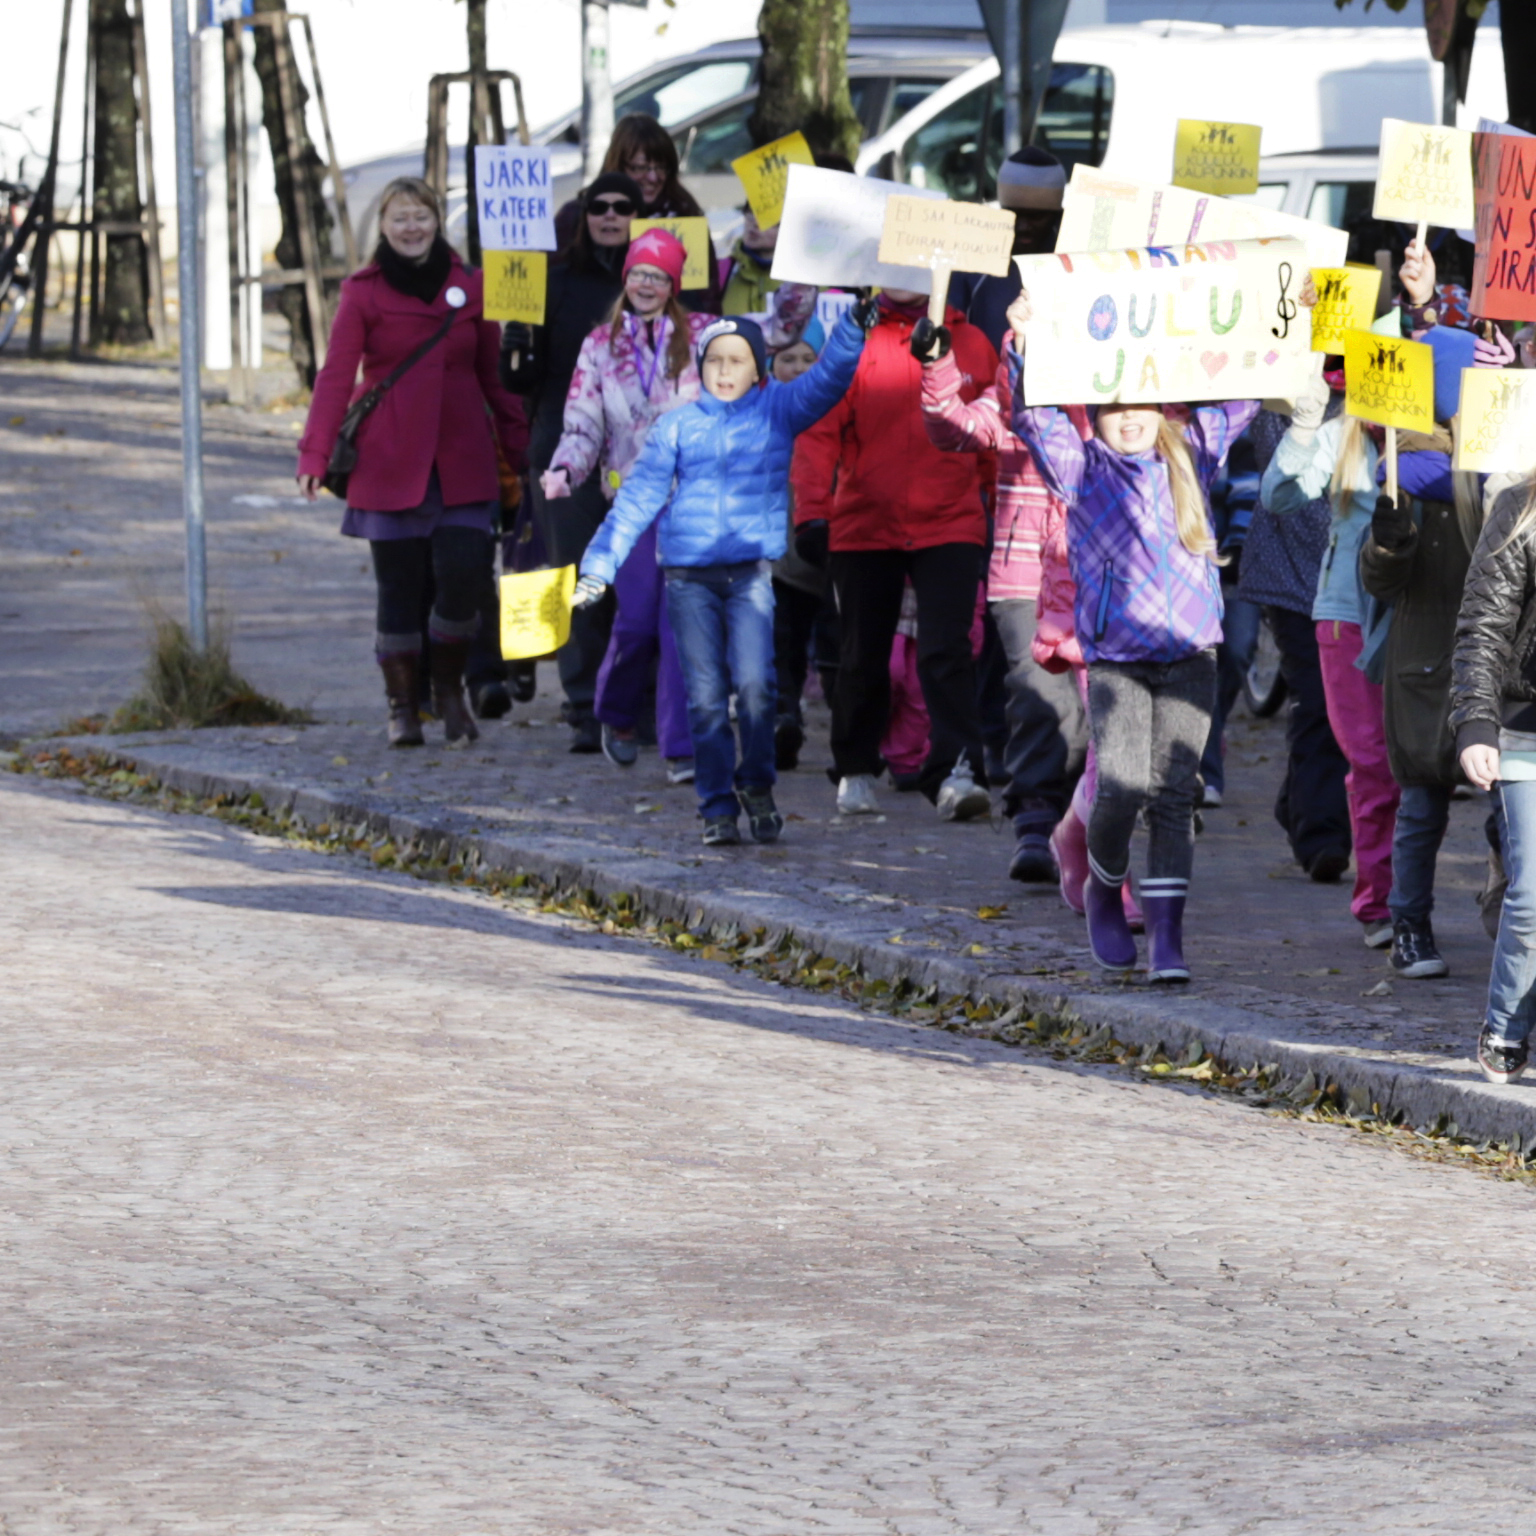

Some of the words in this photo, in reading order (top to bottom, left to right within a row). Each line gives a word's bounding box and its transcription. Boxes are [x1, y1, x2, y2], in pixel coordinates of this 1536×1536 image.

[483, 150, 547, 189] JÄRKI
[1363, 369, 1412, 388] KOULU
[1359, 381, 1416, 402] KUULUU
[1350, 392, 1427, 417] KAUPUNKIN
